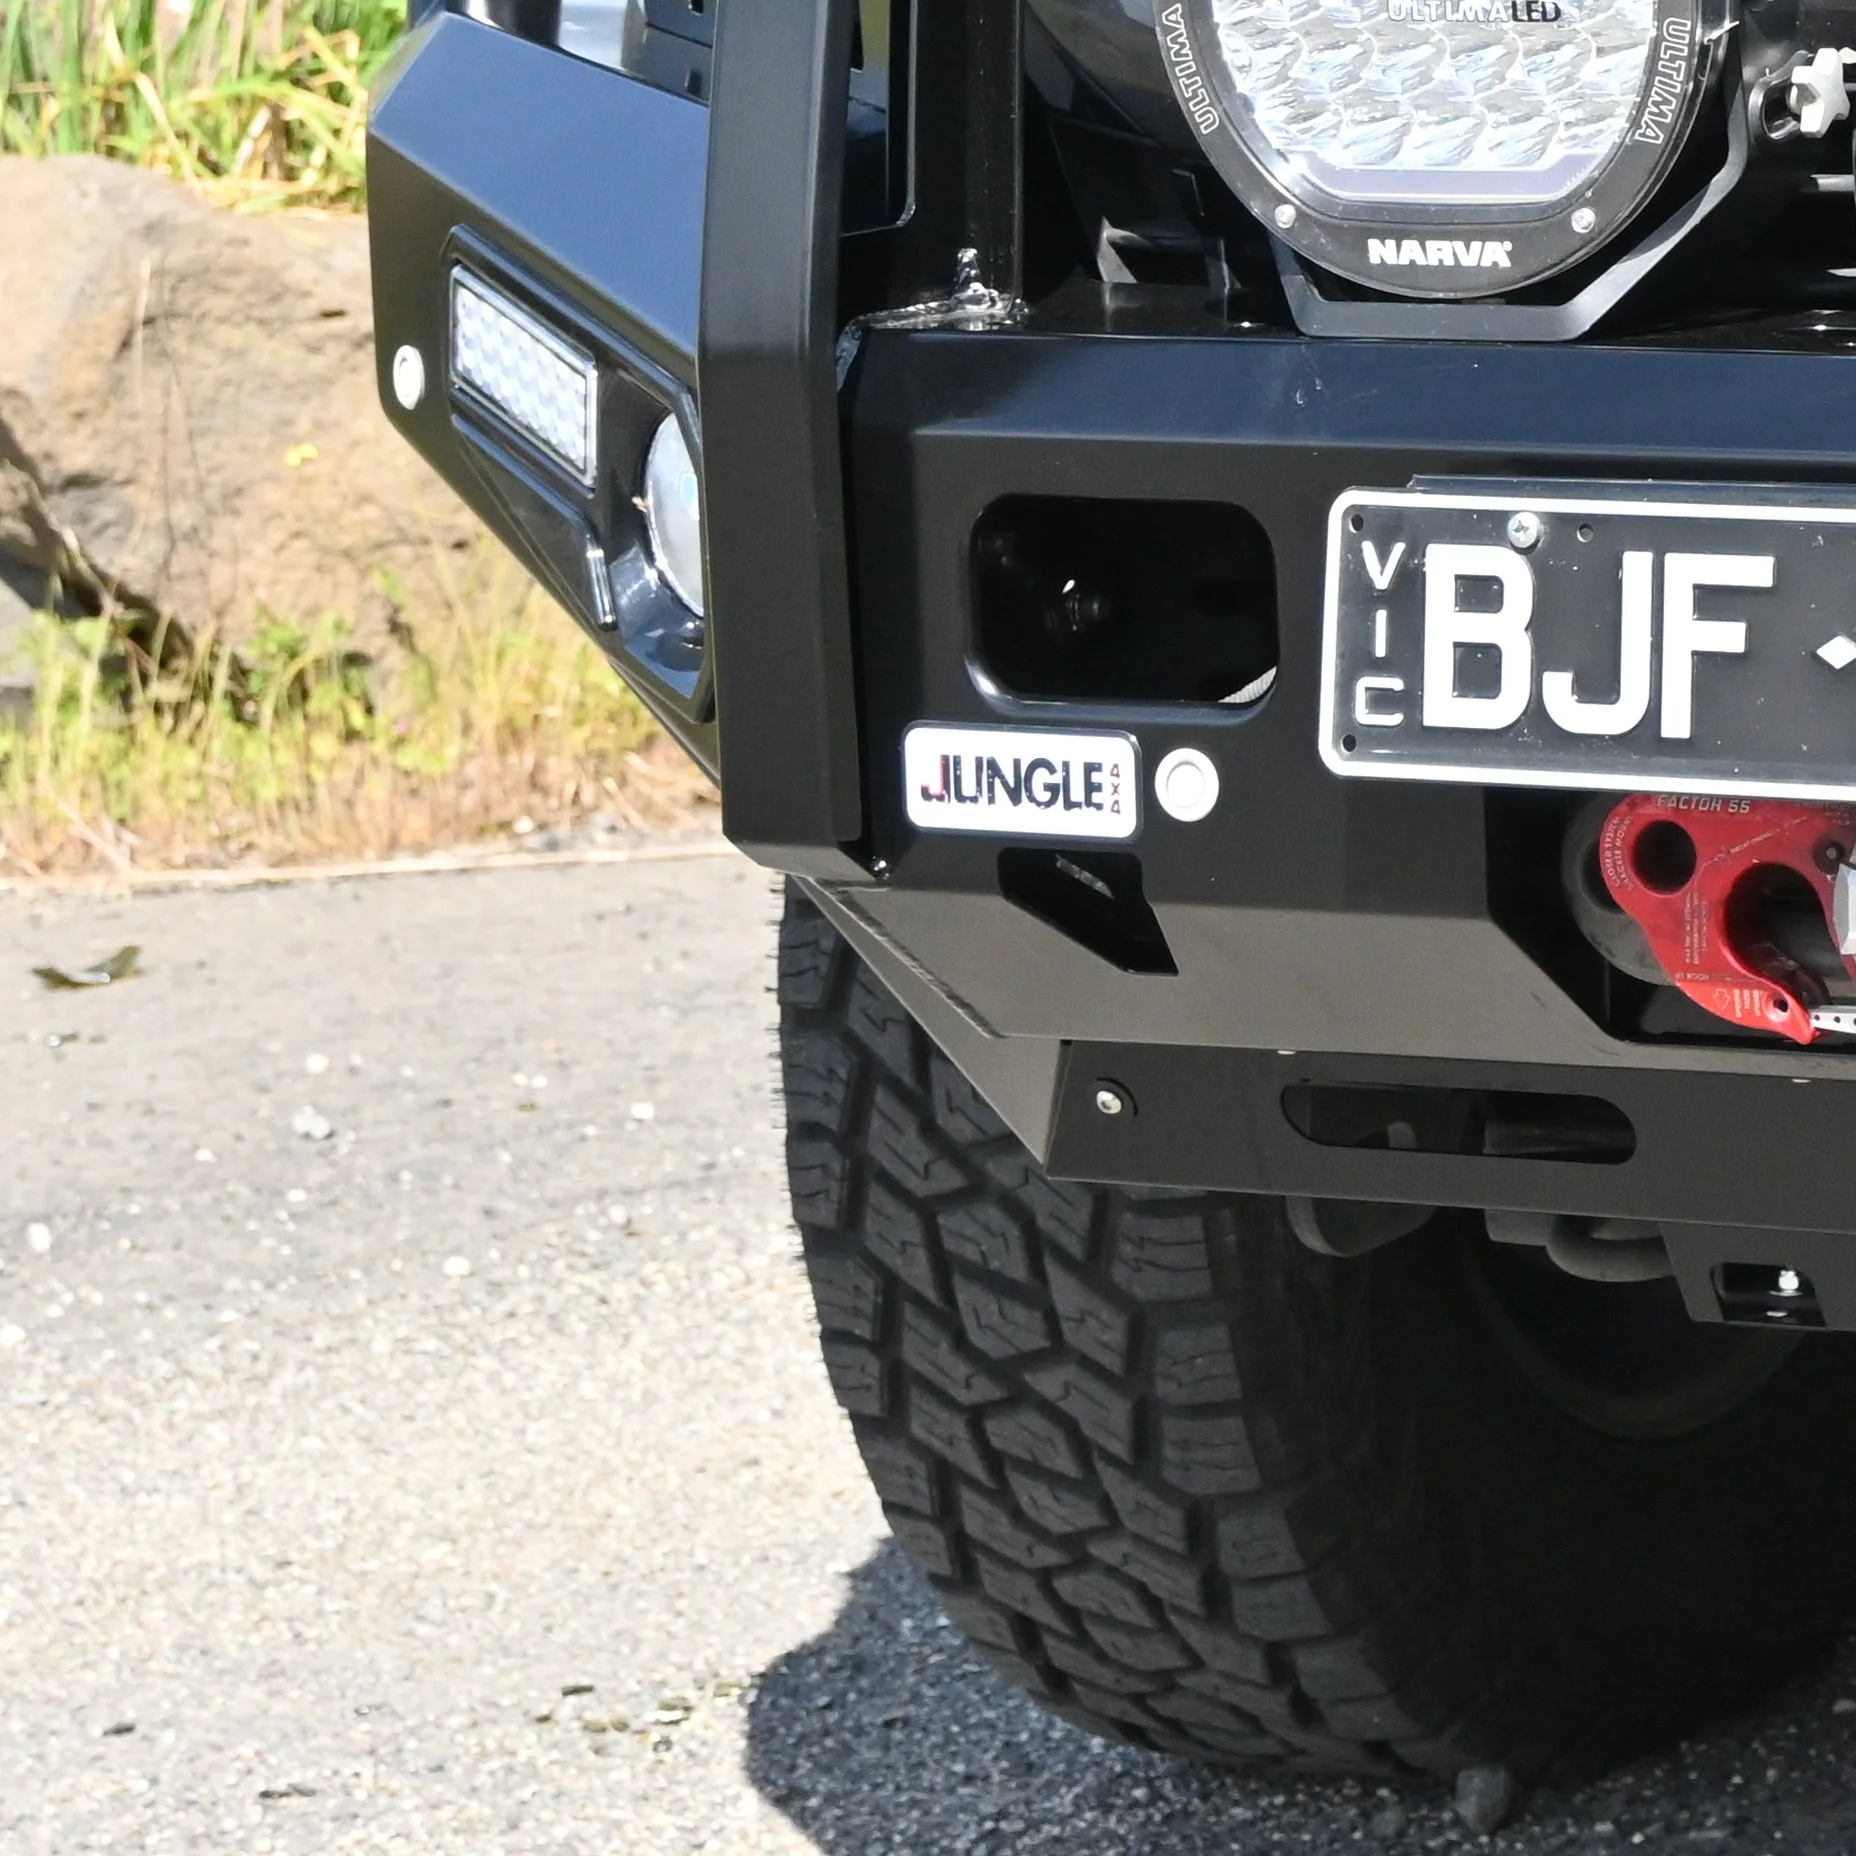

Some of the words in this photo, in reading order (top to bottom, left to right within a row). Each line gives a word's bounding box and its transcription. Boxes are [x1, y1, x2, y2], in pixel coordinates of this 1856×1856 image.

[1161, 3, 1220, 134] ULTIMA
[1635, 17, 1691, 144] ULTIMA
[1367, 238, 1509, 267] NARVA
[1355, 540, 1406, 726] VIC
[920, 754, 1104, 811] JUNGLE
[1656, 795, 1721, 812] FACTOR
